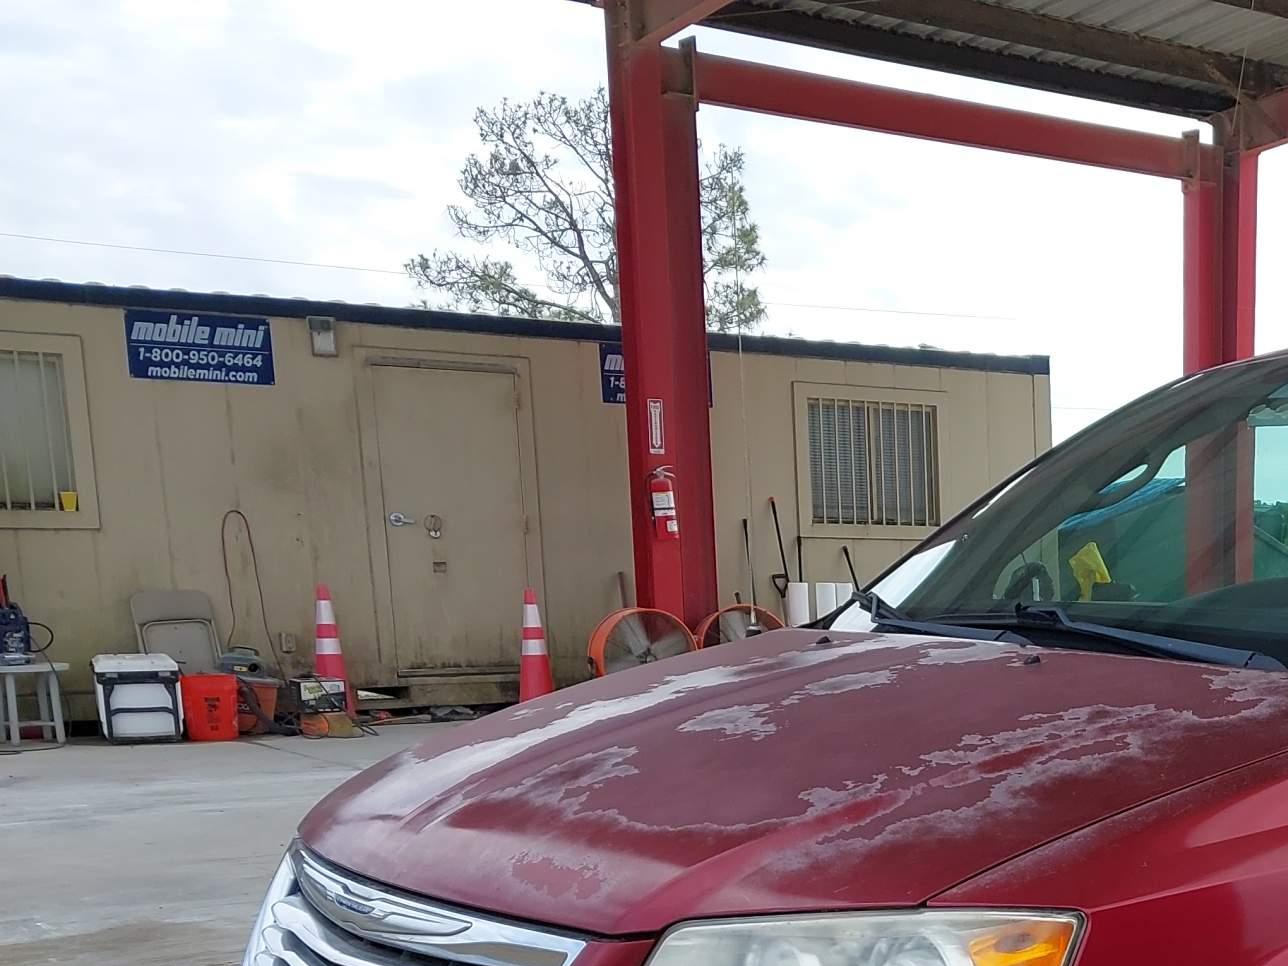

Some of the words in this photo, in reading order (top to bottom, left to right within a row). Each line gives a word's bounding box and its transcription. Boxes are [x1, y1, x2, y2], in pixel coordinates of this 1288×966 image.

[131, 315, 210, 344] mobile
[213, 324, 265, 348] mini
[138, 347, 263, 367] 1-800-950-6464
[147, 365, 258, 382] mobilemini.com
